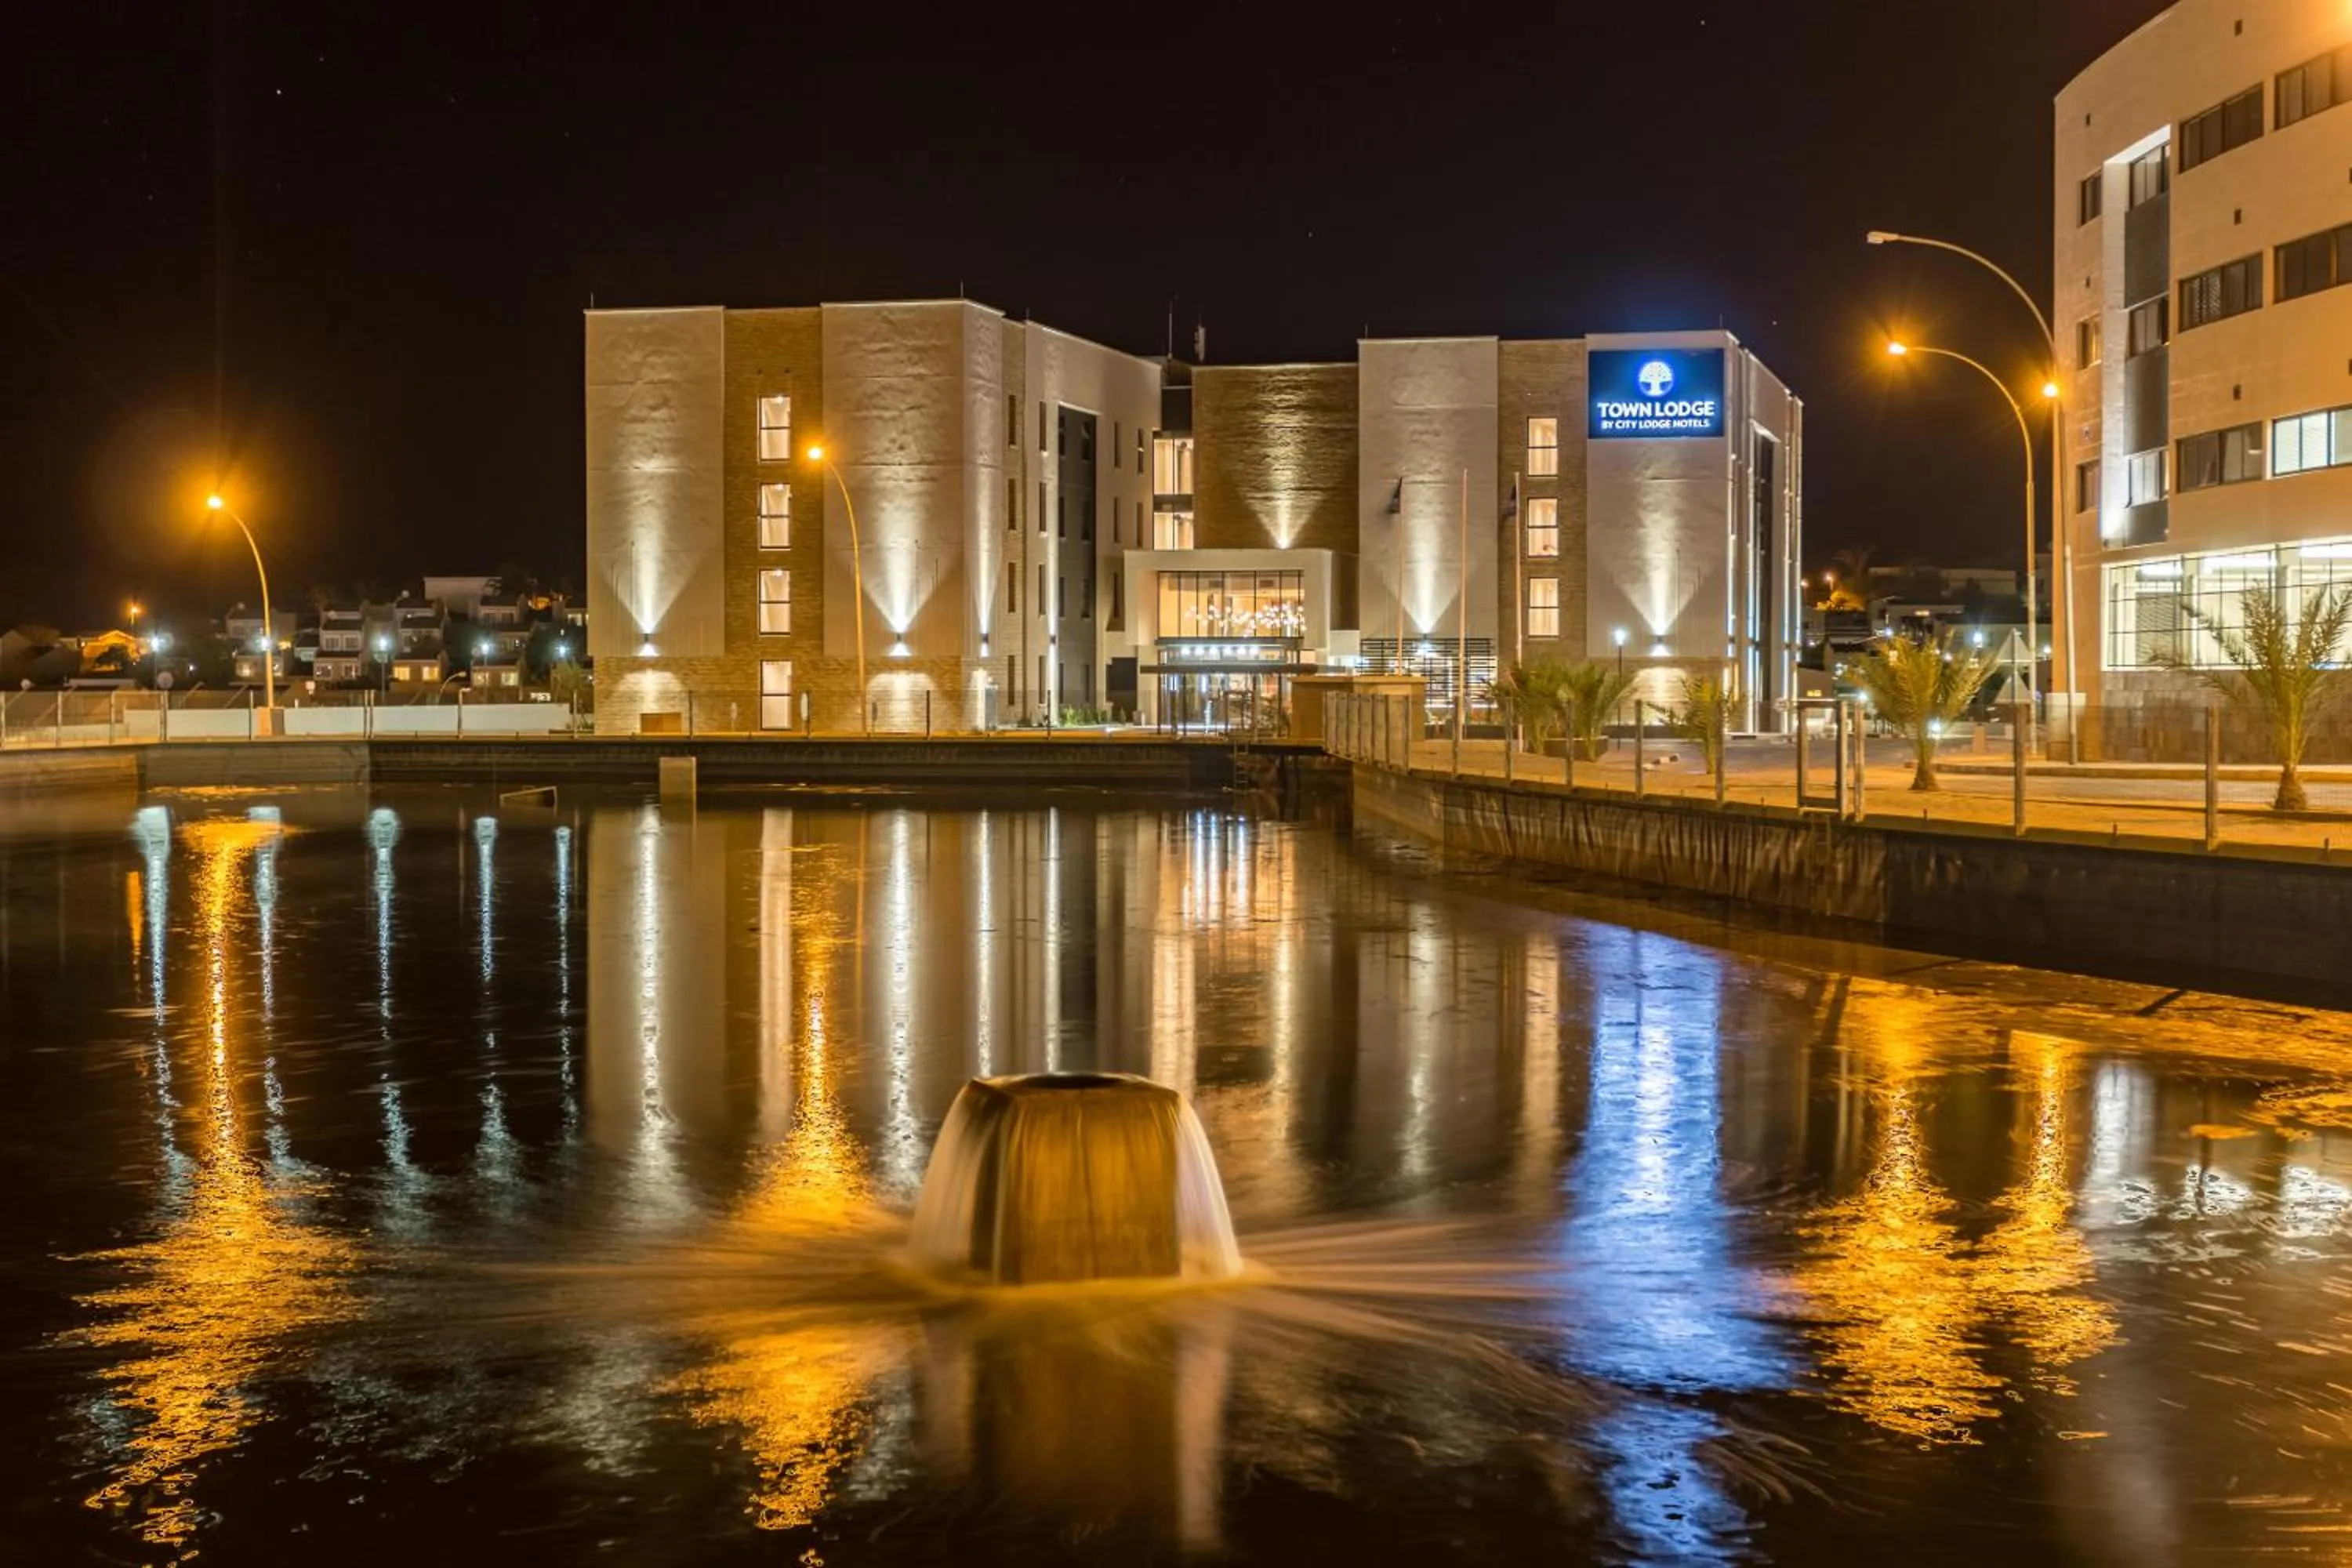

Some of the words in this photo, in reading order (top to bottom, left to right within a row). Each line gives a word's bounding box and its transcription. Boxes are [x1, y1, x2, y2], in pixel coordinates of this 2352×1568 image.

[1597, 401, 1652, 418] TOWN
[1656, 401, 1715, 416] LODGE
[1602, 420, 1614, 429] BY
[1616, 419, 1637, 429] CITY
[1639, 419, 1671, 429] LODGE
[1673, 419, 1710, 428] HOTELS
